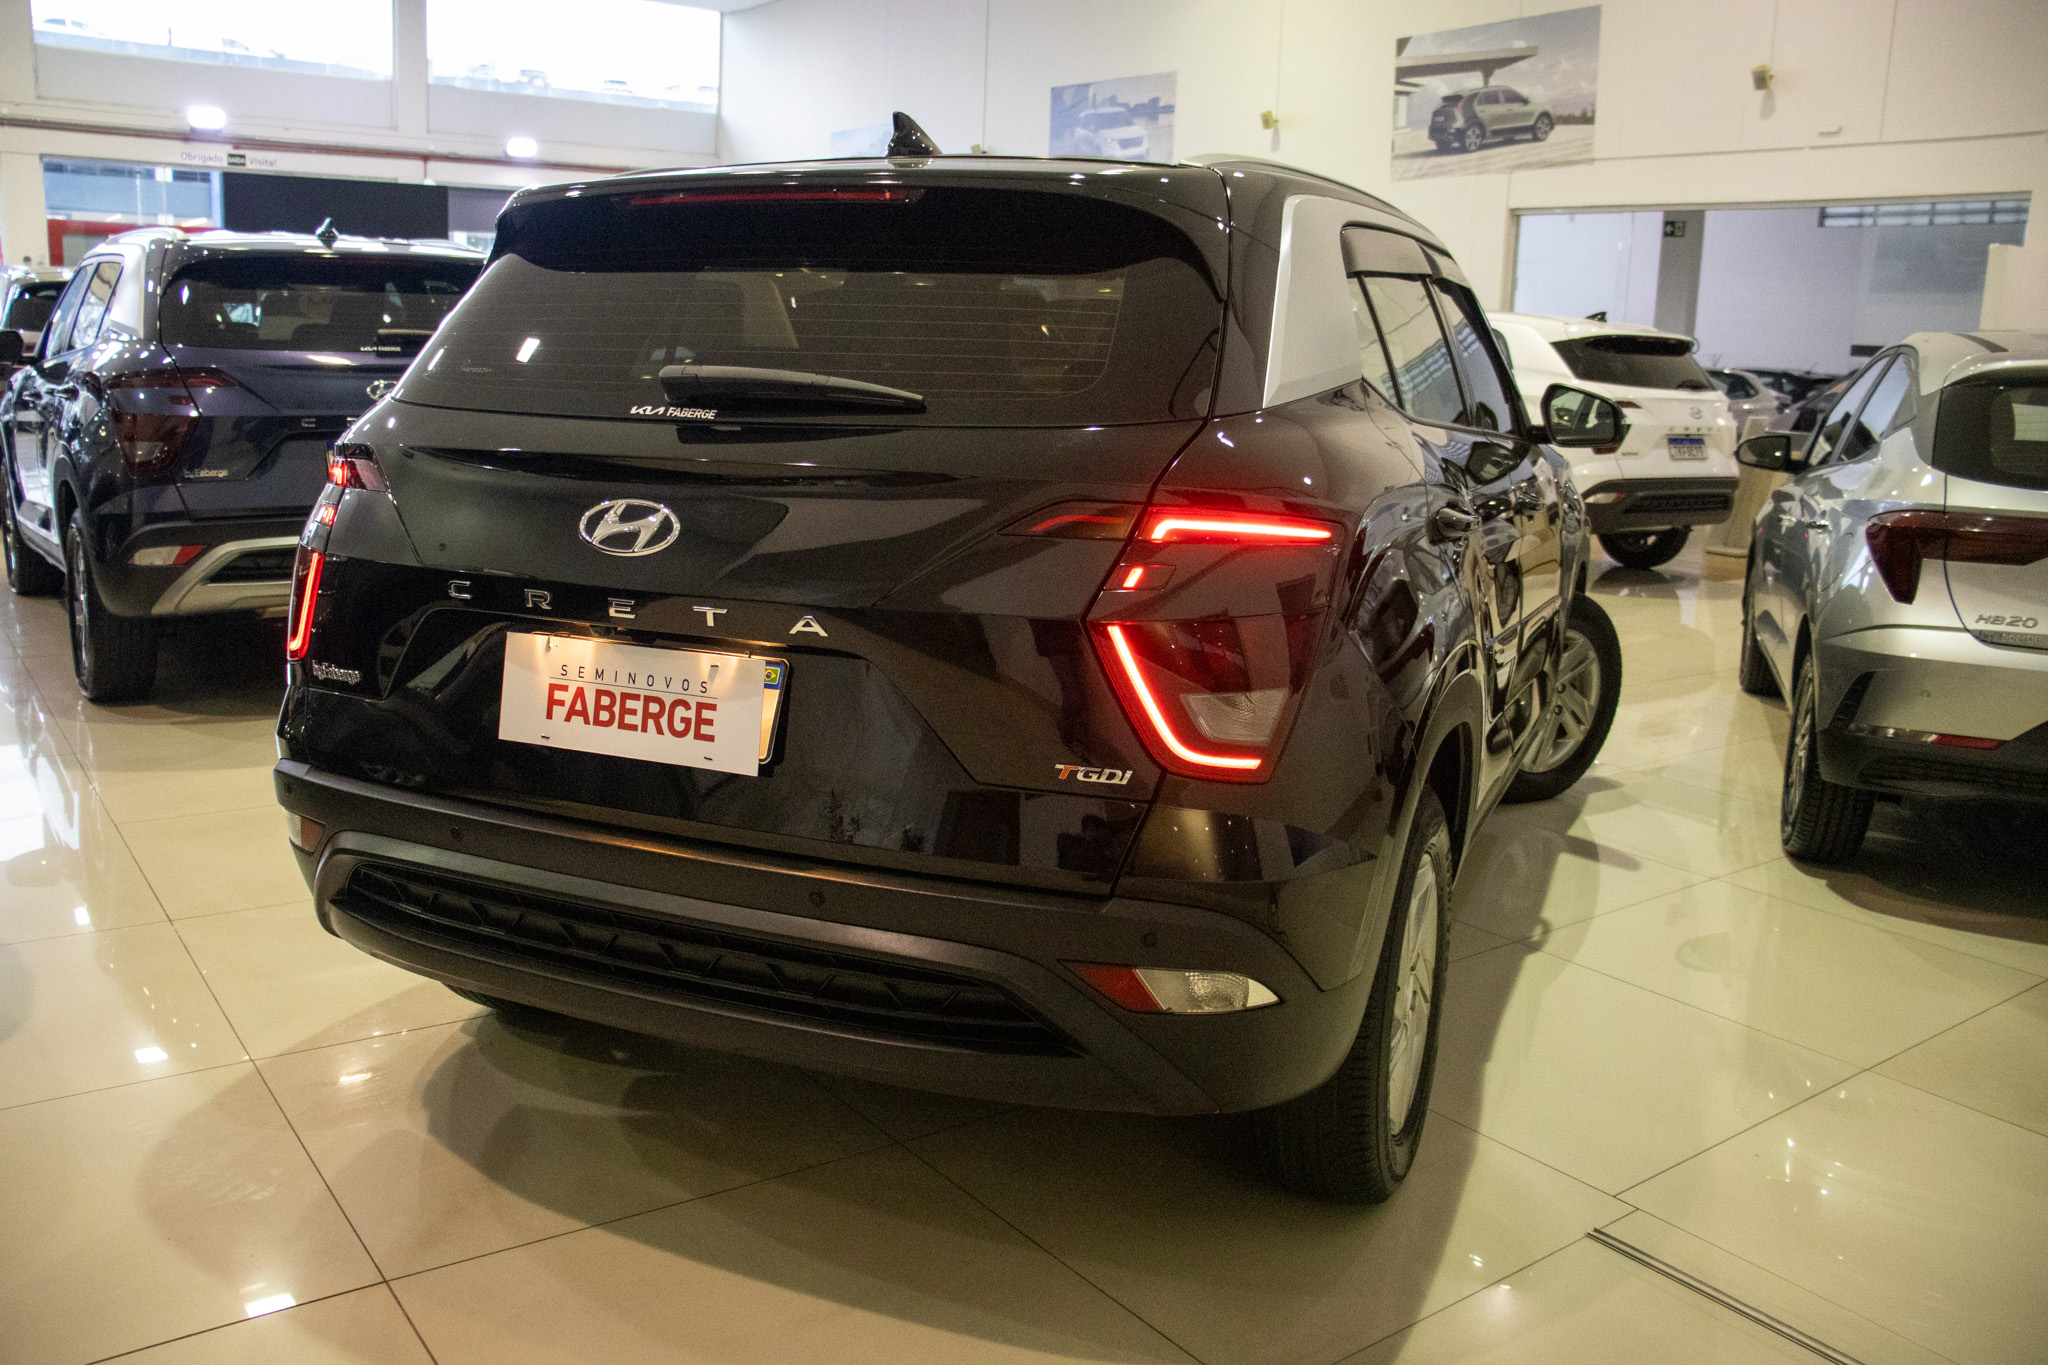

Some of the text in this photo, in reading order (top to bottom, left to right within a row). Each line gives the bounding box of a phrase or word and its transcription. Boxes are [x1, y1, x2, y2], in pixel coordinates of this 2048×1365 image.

[180, 151, 277, 167] Obrigado Visita!
[666, 406, 718, 420] FABERGE
[447, 579, 829, 638] CRETA
[1975, 614, 2039, 628] HB20
[560, 664, 708, 694] SEMINOVOS
[545, 682, 718, 743] FABERGE
